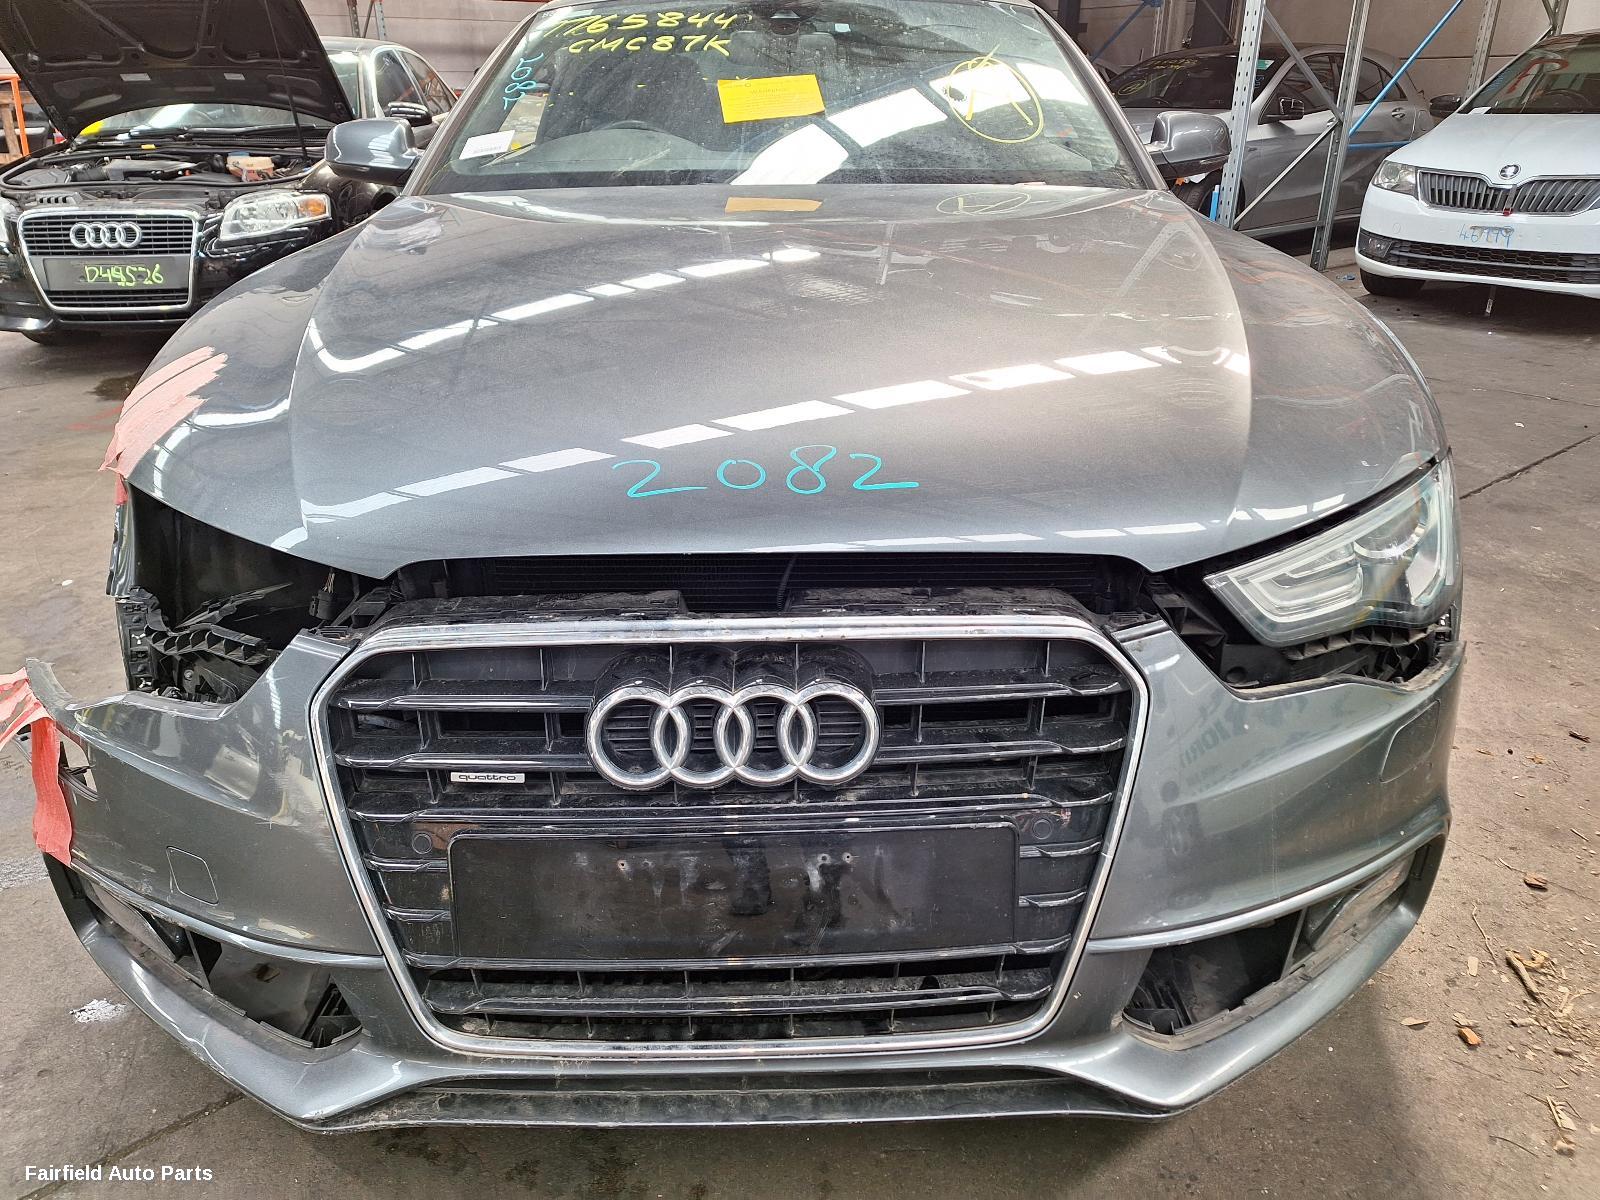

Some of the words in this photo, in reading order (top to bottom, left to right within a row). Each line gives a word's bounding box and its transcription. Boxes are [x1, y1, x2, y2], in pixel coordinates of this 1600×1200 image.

[568, 34, 732, 57] CMC87K
[611, 444, 919, 497] 2082
[458, 774, 517, 782] quattro
